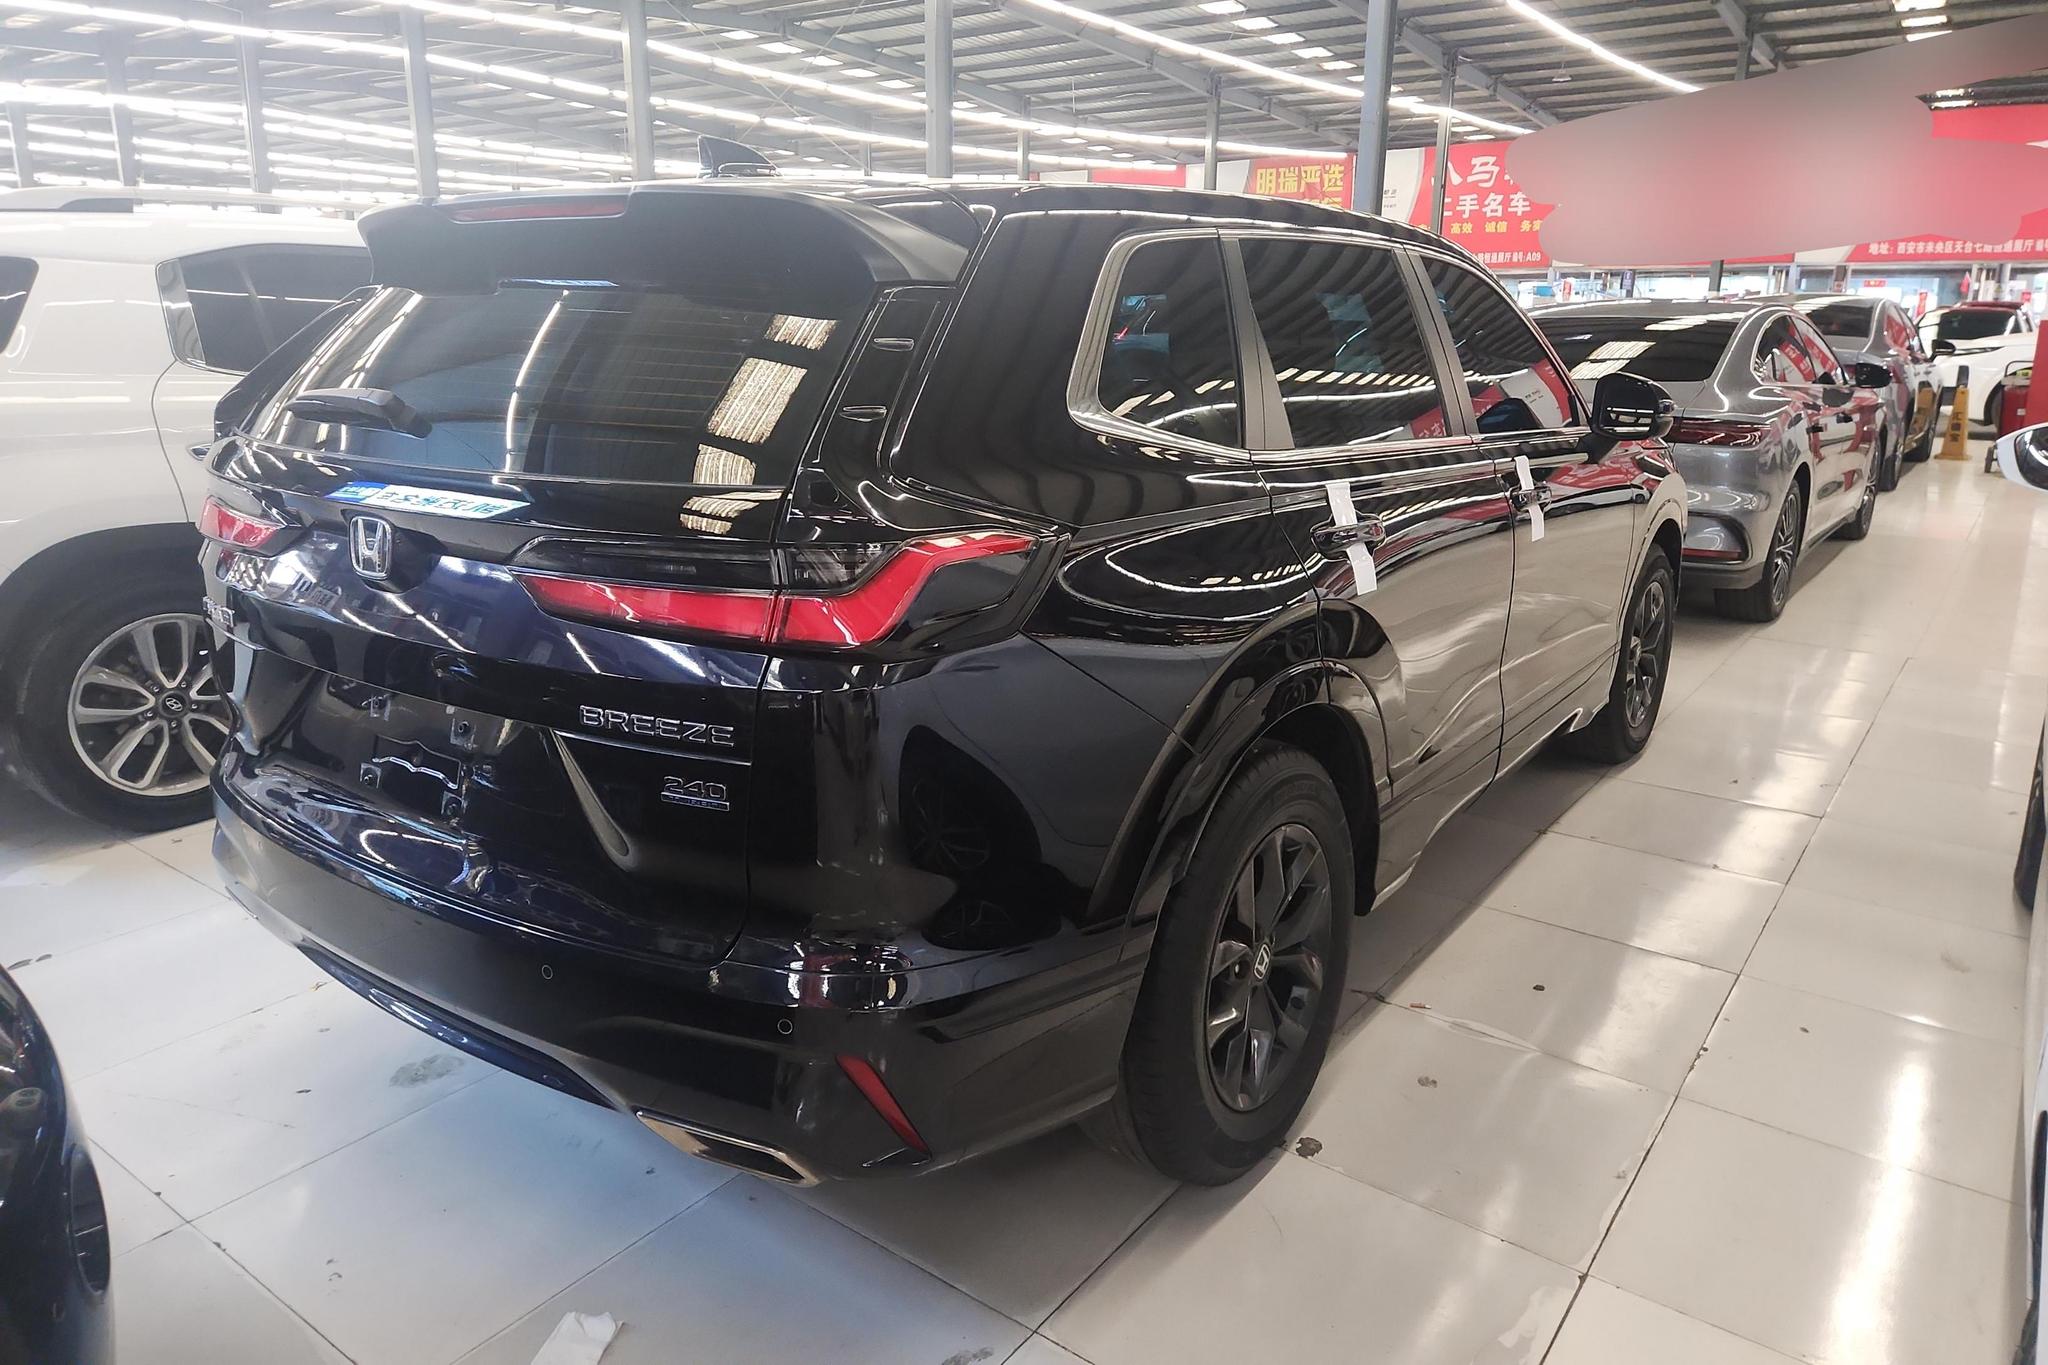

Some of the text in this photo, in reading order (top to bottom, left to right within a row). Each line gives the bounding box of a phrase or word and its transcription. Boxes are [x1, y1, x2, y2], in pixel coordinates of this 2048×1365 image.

[1256, 164, 1345, 195] 明瑞严选
[1450, 222, 1473, 234] 高效
[1485, 221, 1508, 233] 诚信
[579, 704, 735, 748] BREEZE
[663, 775, 727, 801] 240
